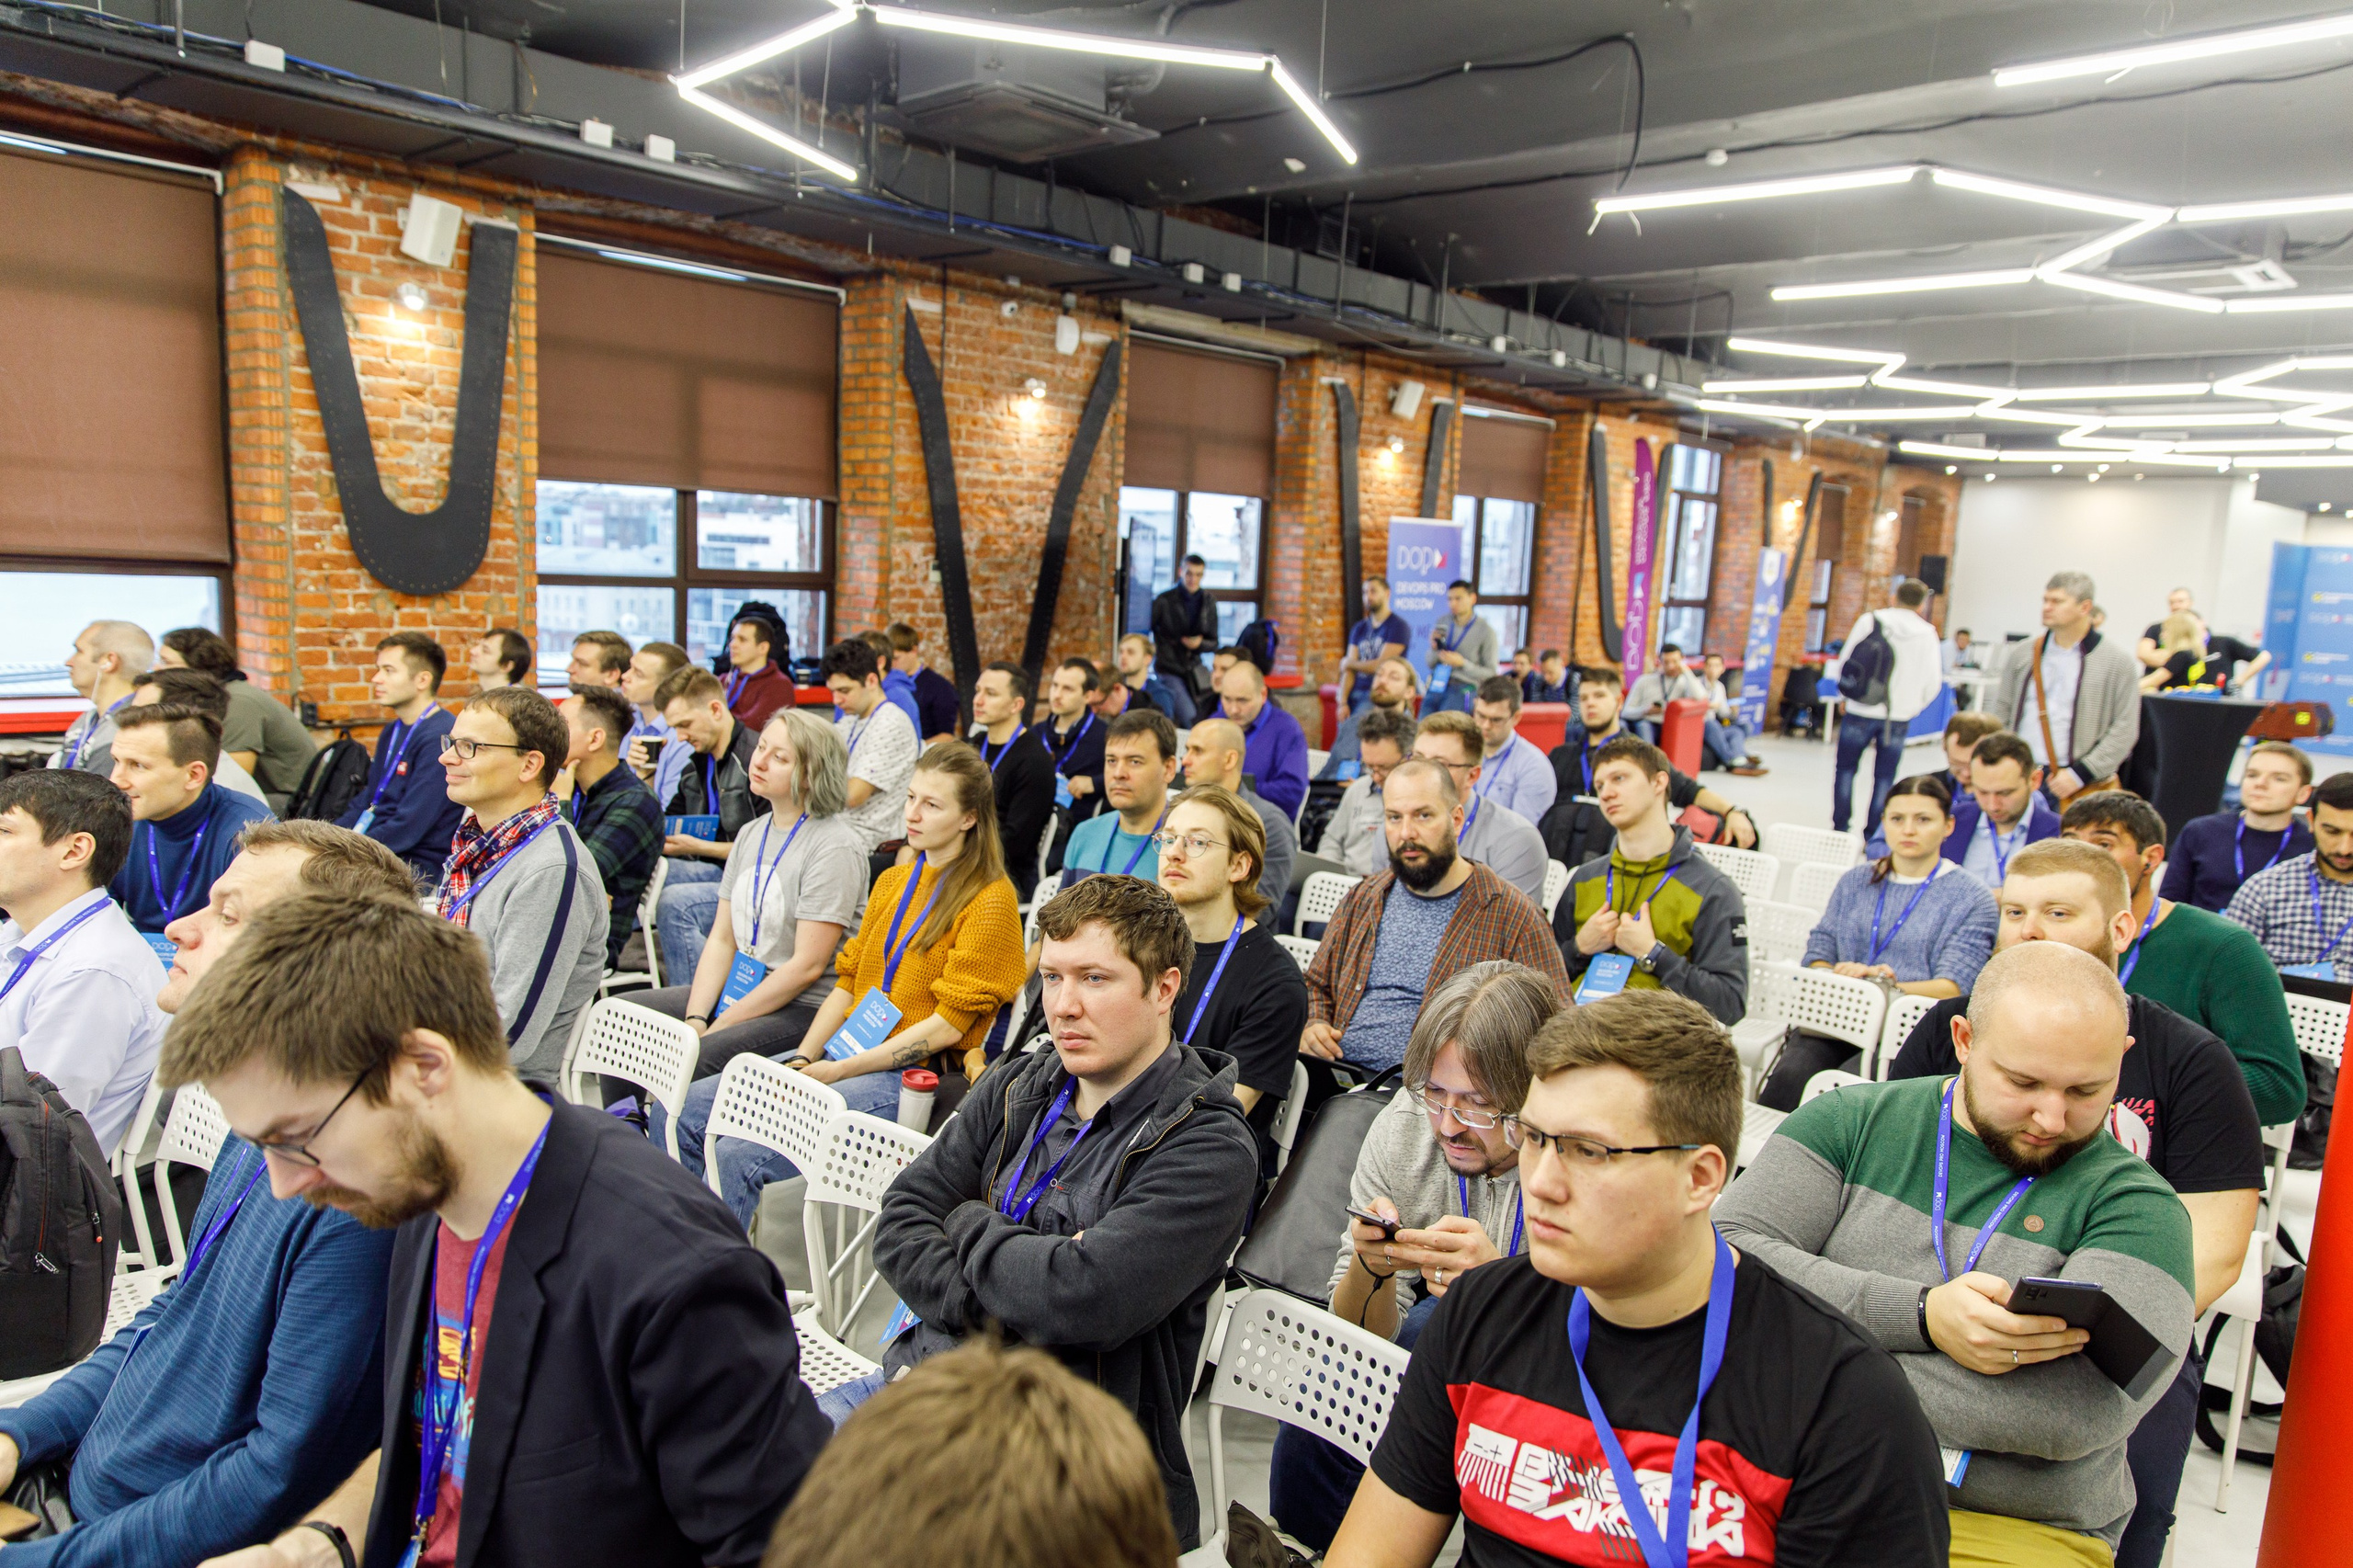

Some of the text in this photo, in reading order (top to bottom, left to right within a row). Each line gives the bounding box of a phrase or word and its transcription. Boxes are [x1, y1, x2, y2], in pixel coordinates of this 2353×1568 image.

[1395, 580, 1447, 597] DEVOPS PRO
[1394, 597, 1435, 611] MOSCOW
[2006, 1191, 2019, 1205] DEVOPS
[1988, 1212, 2001, 1229] MOSCOW
